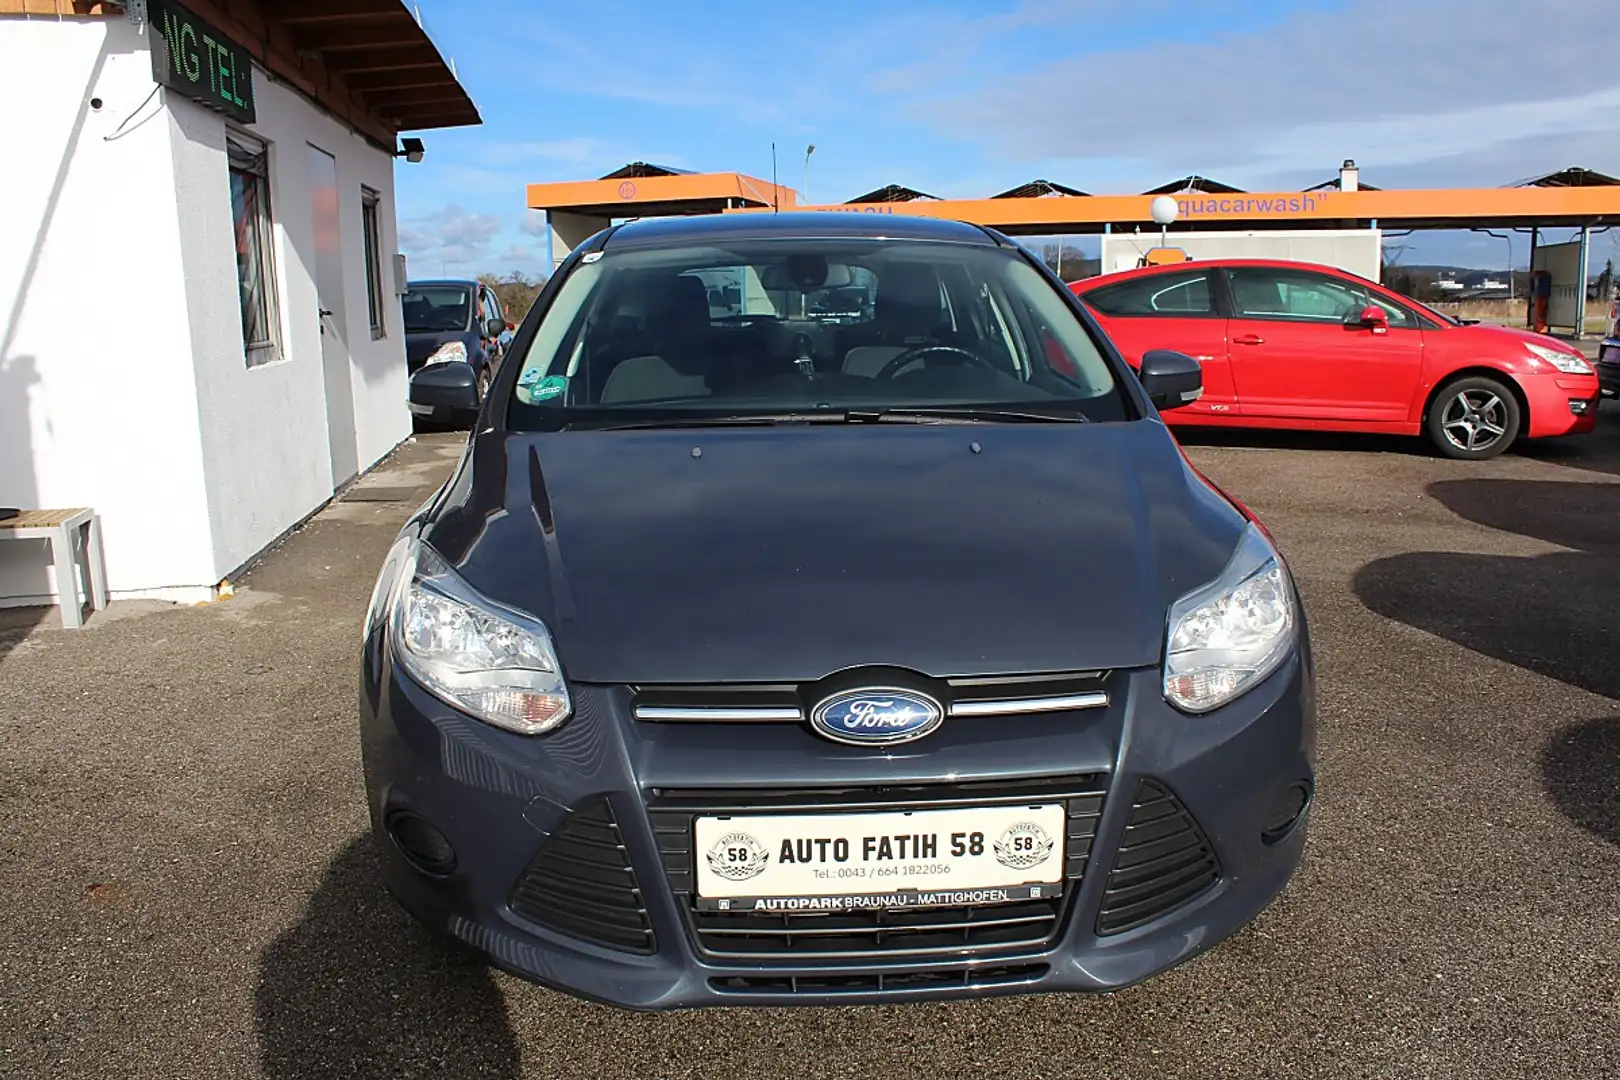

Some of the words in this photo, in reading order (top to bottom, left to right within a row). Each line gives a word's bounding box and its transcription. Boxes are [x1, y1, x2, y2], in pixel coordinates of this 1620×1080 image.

[1177, 193, 1328, 217] quacarwash"
[843, 700, 912, 729] Ford
[779, 838, 849, 864] AUTO
[862, 833, 937, 861] FATIH
[950, 831, 985, 857] 58
[1013, 836, 1033, 852] 58
[727, 847, 748, 862] 58
[838, 867, 867, 879] 0043
[877, 865, 899, 877] 664
[902, 864, 951, 876] 1822056
[917, 889, 1008, 904] MATTIGHOFEN
